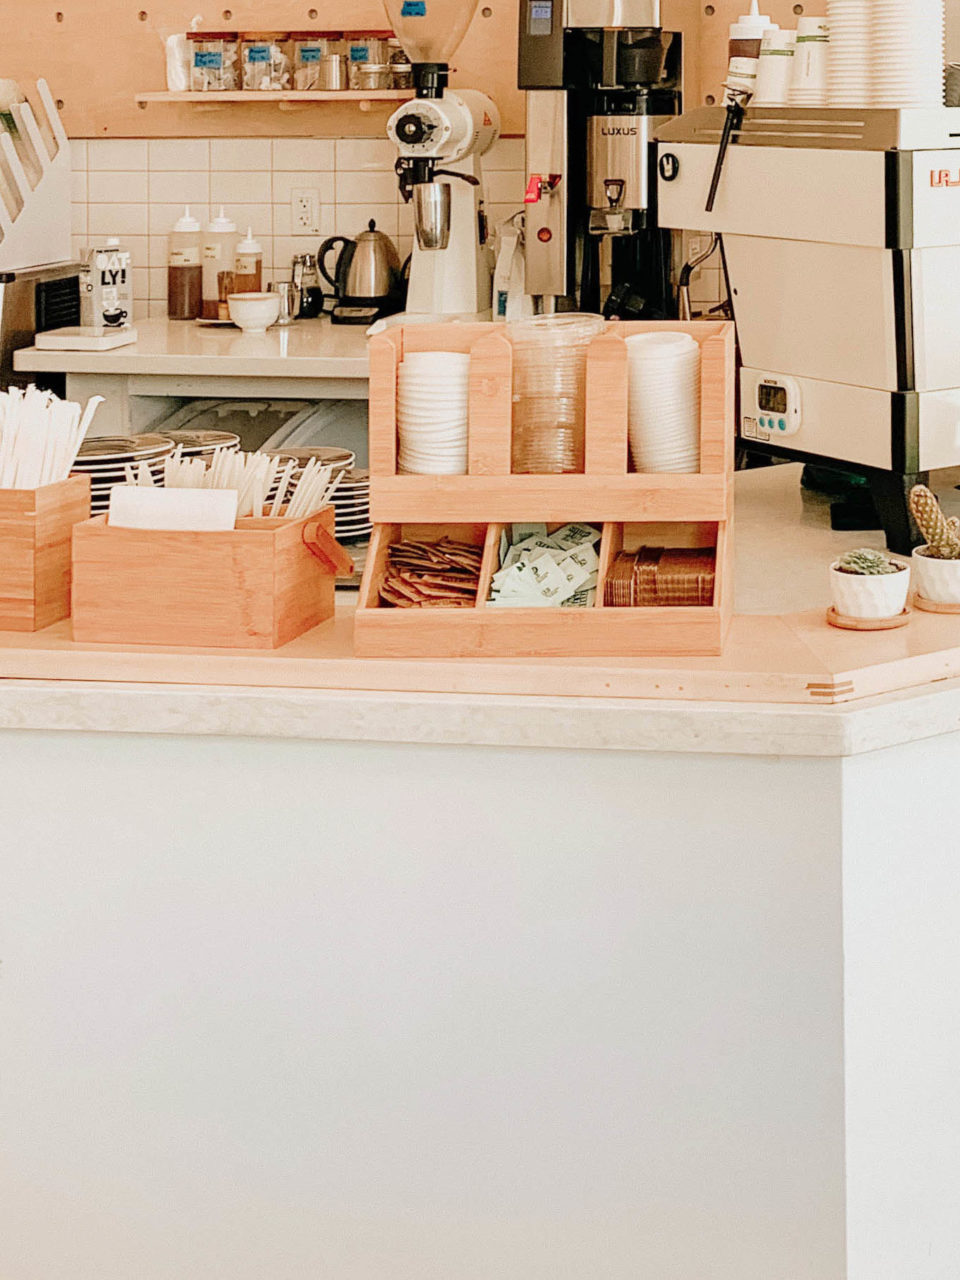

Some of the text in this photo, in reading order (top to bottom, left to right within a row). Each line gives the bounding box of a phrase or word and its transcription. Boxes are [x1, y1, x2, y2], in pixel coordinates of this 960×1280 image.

[601, 127, 638, 136] LUXUS
[96, 252, 130, 270] OAT
[101, 269, 126, 286] LY!
